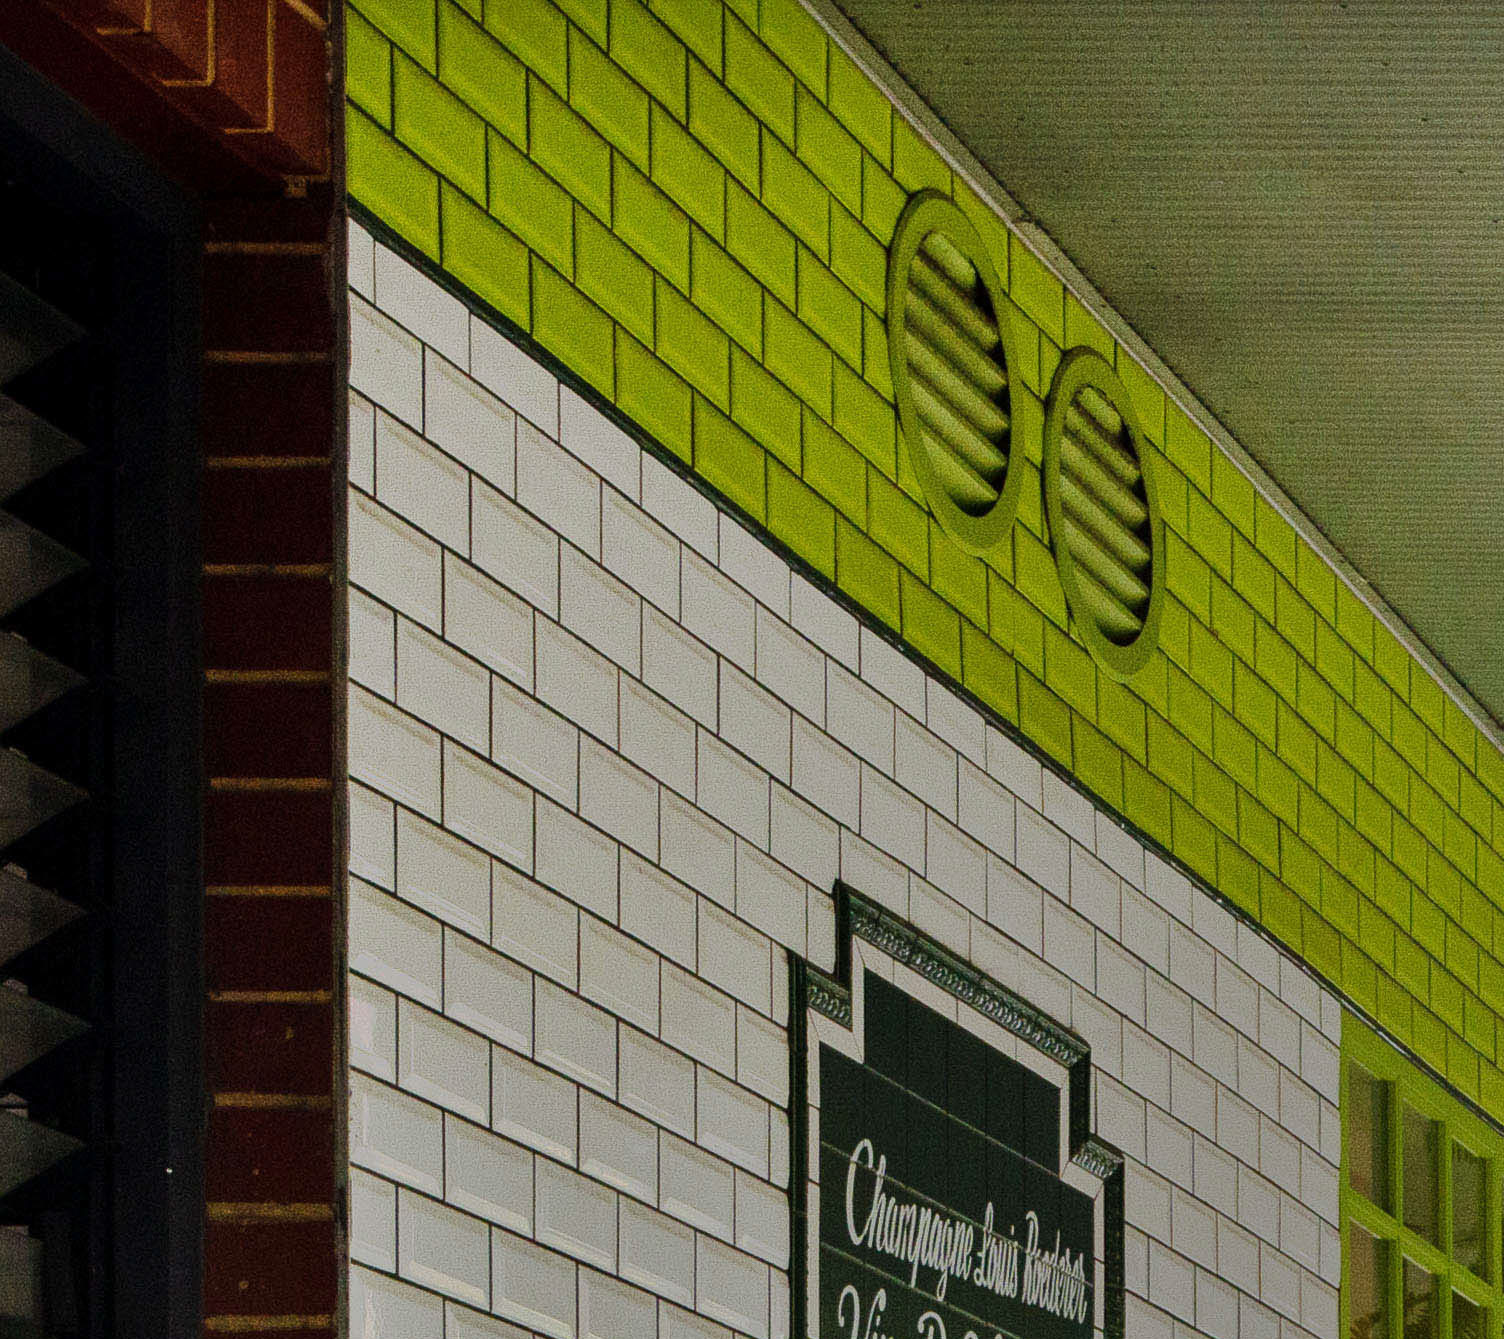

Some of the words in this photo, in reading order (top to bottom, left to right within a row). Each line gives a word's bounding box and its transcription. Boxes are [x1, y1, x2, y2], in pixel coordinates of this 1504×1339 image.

[846, 1138, 973, 1302] Champagne
[974, 1201, 1018, 1298] Louis
[1022, 1210, 1087, 1324] Roederer
